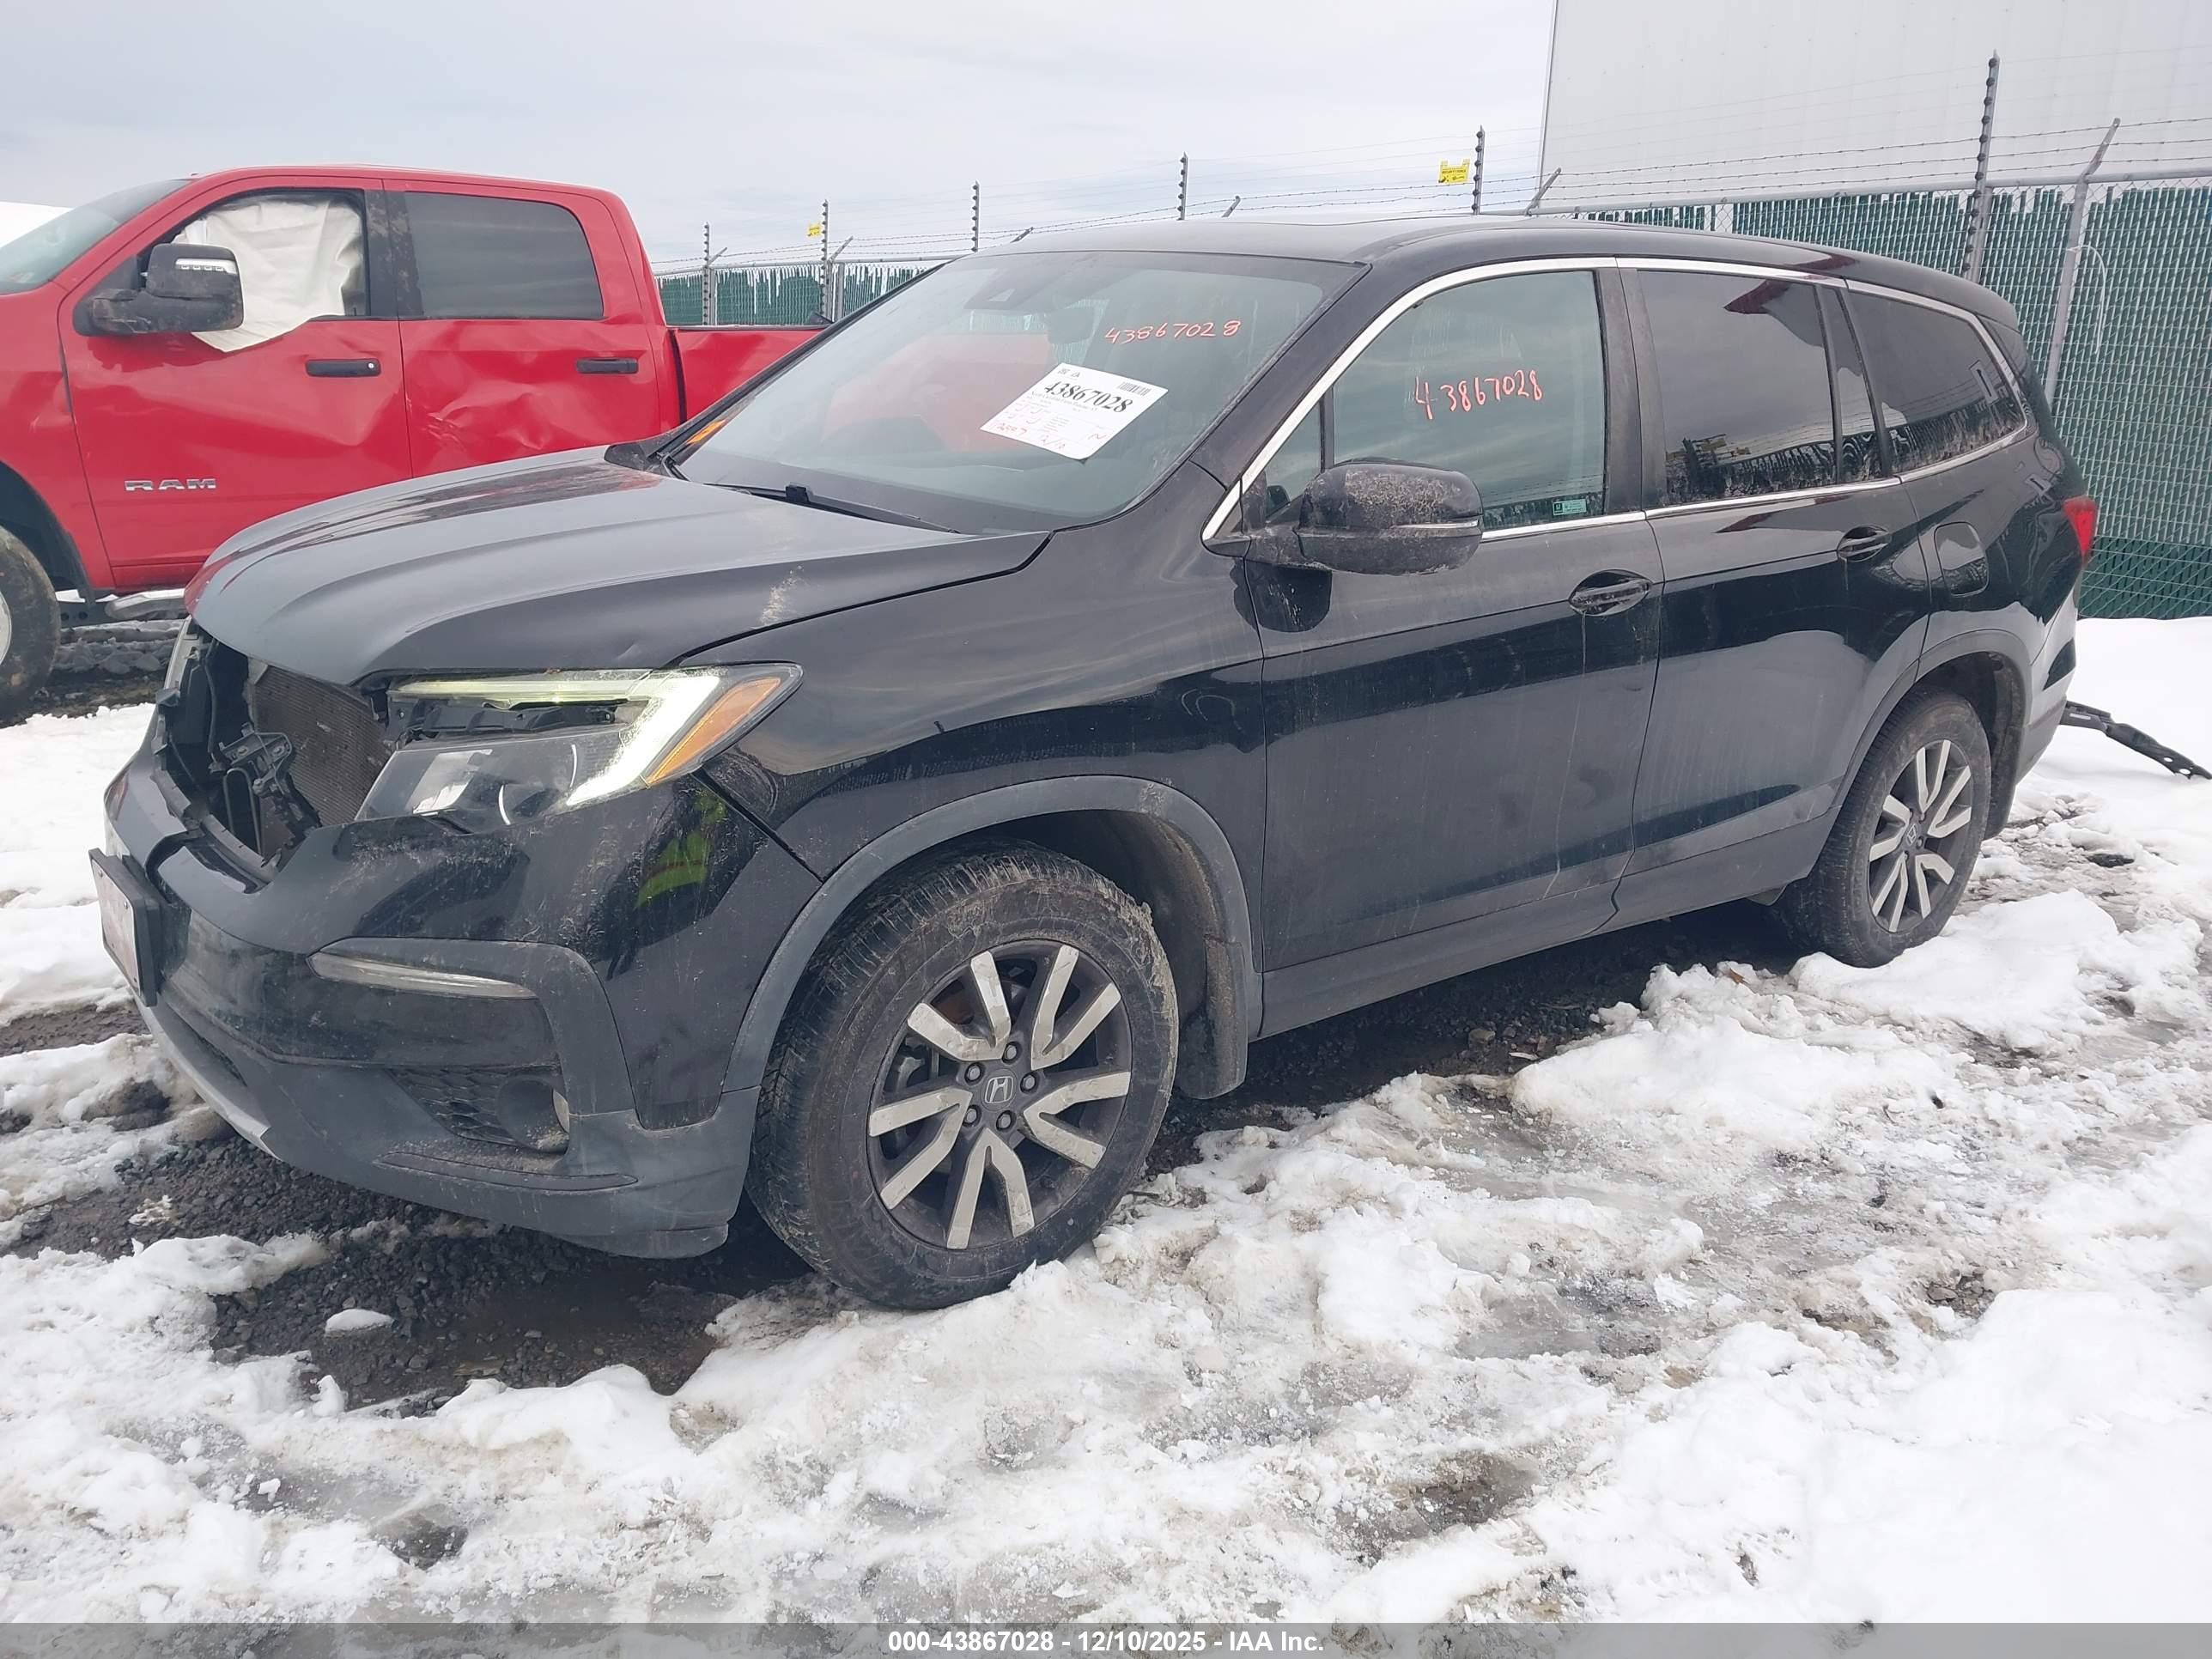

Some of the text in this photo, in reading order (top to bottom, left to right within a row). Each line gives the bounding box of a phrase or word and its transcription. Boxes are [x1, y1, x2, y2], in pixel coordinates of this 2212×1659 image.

[1104, 319, 1242, 345] 43867028
[1044, 380, 1133, 413] 43867028
[1415, 369, 1543, 420] 43867028
[124, 478, 216, 491] RAM
